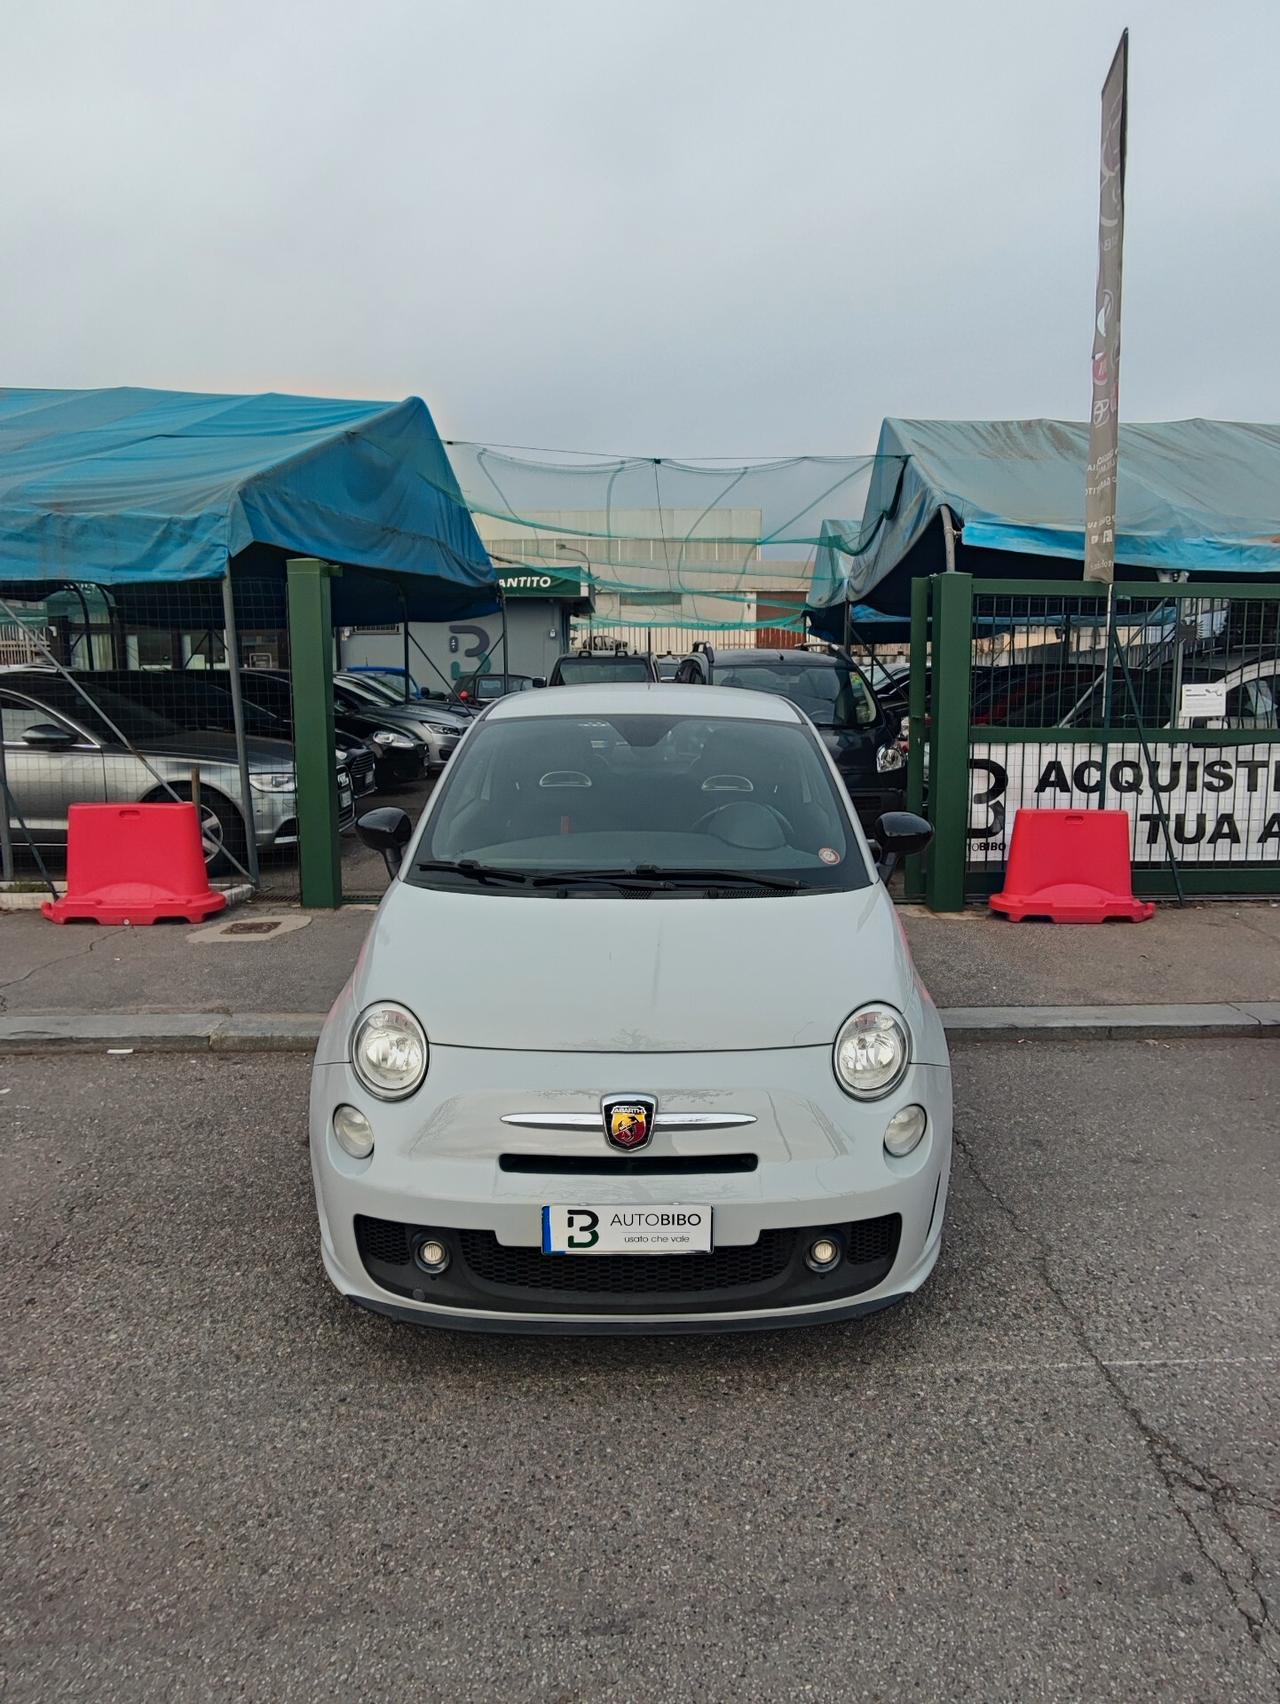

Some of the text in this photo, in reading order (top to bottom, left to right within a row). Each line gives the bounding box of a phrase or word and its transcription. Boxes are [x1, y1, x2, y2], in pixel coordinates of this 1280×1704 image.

[1140, 813, 1241, 844] TUA
[967, 842, 1006, 851] OBIBO
[610, 1213, 701, 1226] AUTOBIBO
[567, 1209, 599, 1248] B
[624, 1234, 690, 1243] usato che vale
